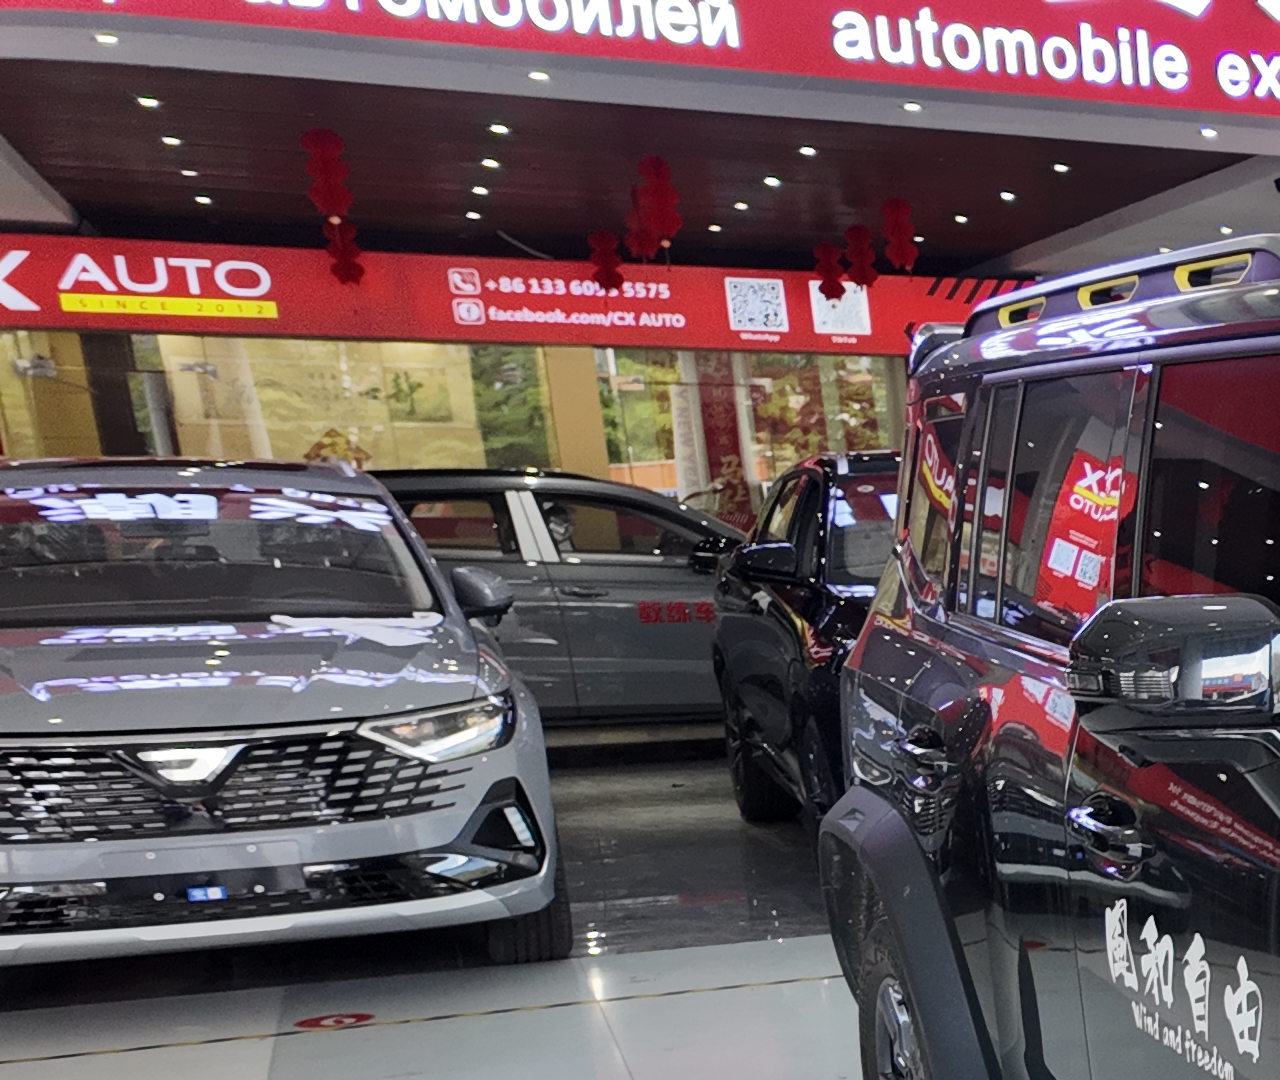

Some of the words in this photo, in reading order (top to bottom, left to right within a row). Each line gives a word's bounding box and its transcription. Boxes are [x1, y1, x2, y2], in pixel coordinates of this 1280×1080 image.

[832, 8, 1189, 91] automobile
[58, 252, 272, 297] AUTO
[484, 276, 526, 293] +86
[528, 278, 566, 295] 133
[622, 281, 671, 300] 5575
[78, 299, 170, 312] SINCE
[196, 302, 264, 315] 2012
[638, 312, 686, 329] AUTO
[1131, 1000, 1160, 1041] Wind
[1162, 1024, 1183, 1054] and
